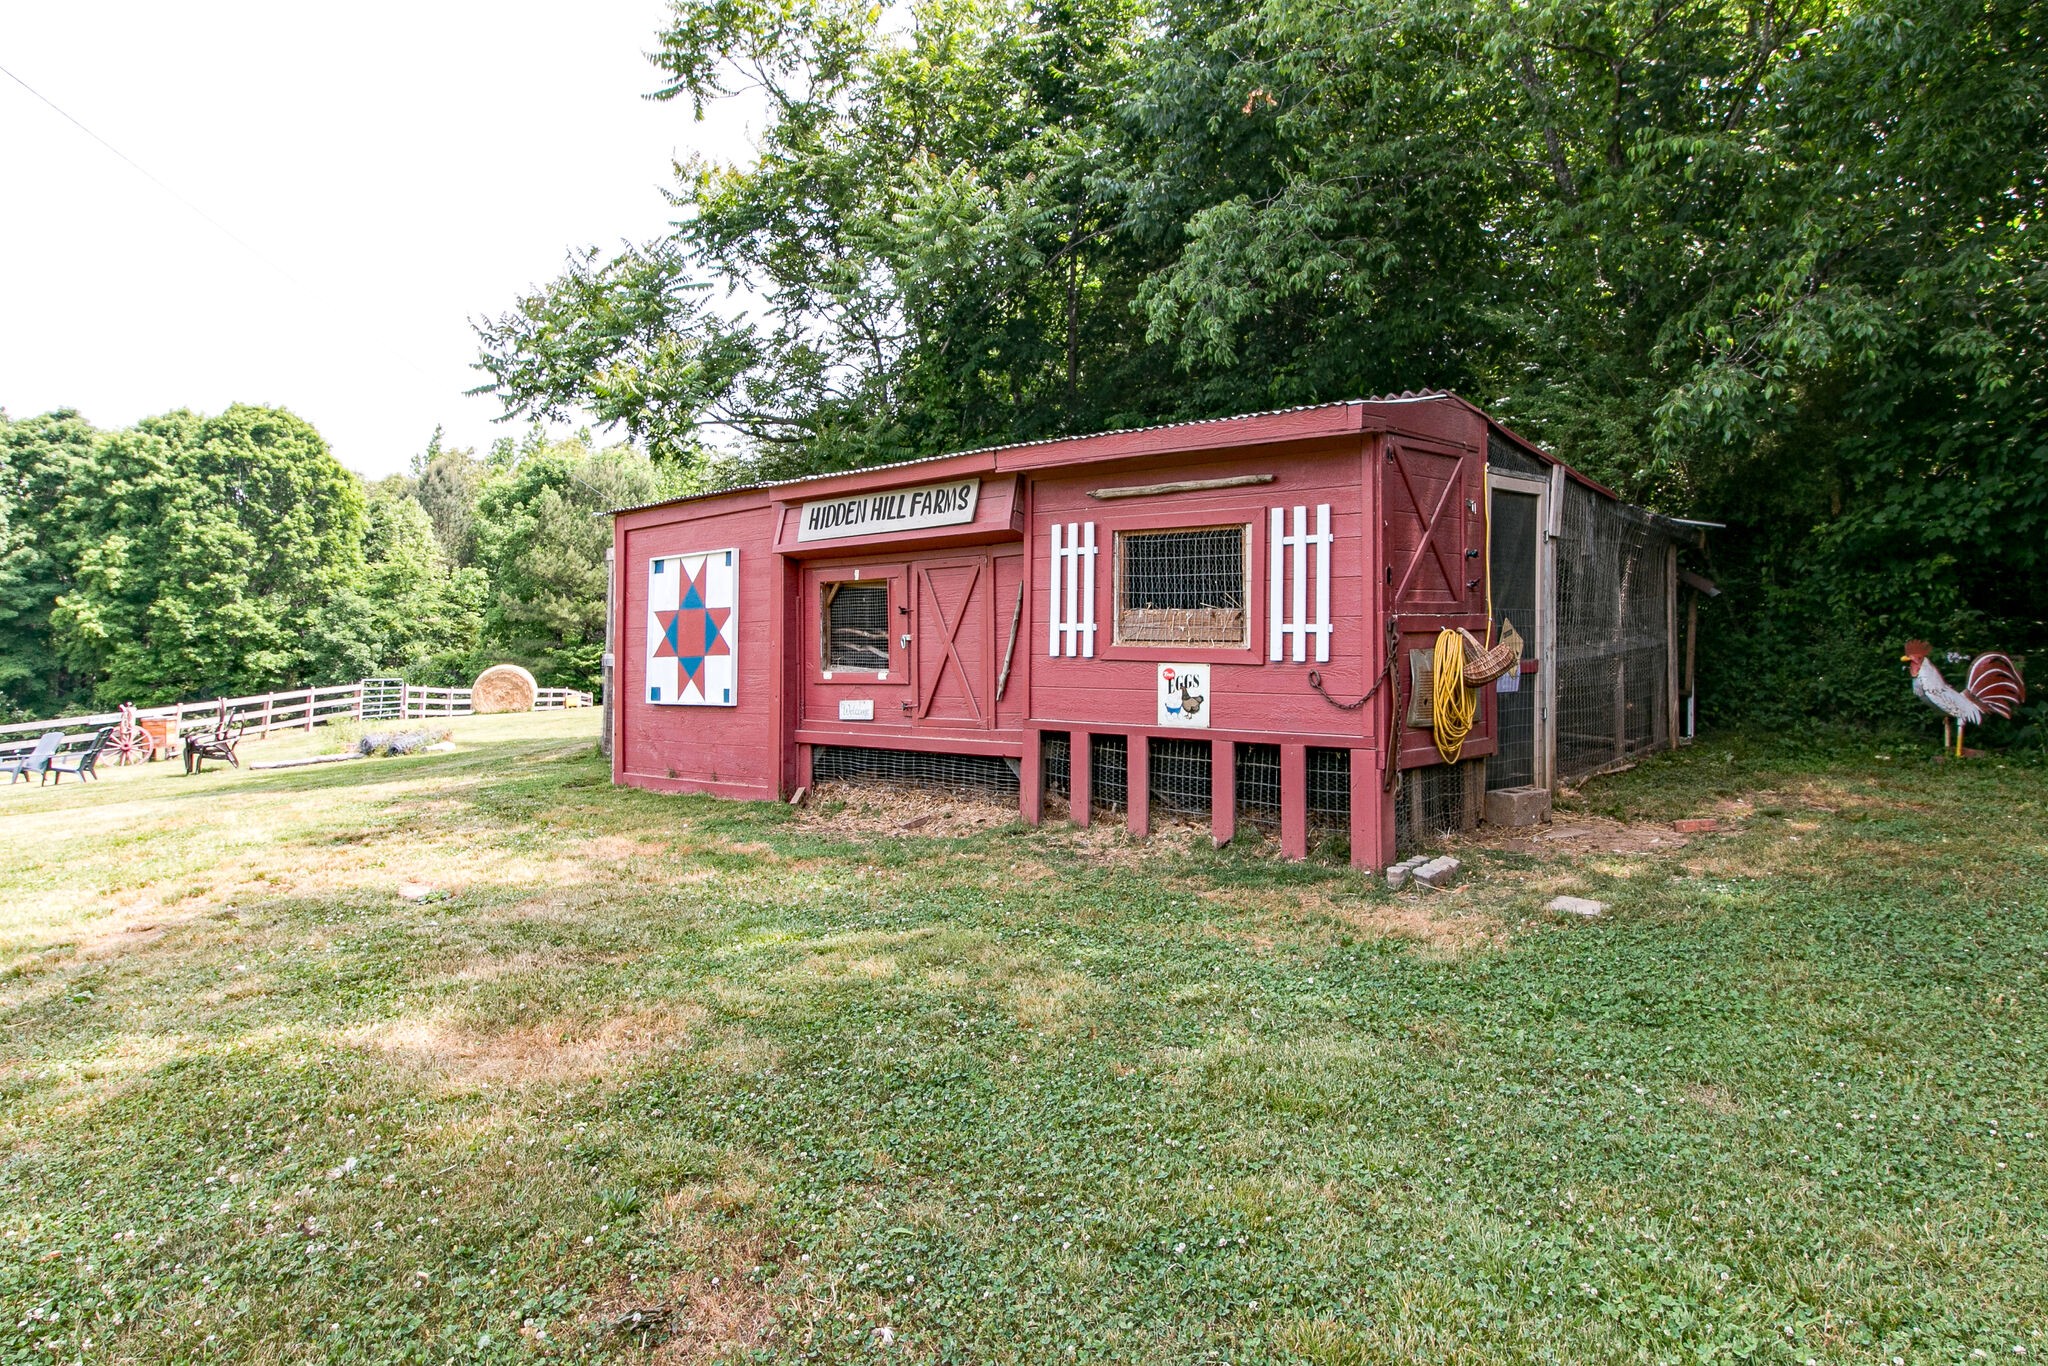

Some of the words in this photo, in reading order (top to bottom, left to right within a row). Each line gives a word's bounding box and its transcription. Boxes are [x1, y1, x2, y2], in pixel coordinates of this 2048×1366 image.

[808, 499, 867, 531] HIDDEN
[870, 494, 906, 521] HILL
[909, 484, 971, 518] FARMS
[1168, 674, 1200, 694] EGGS
